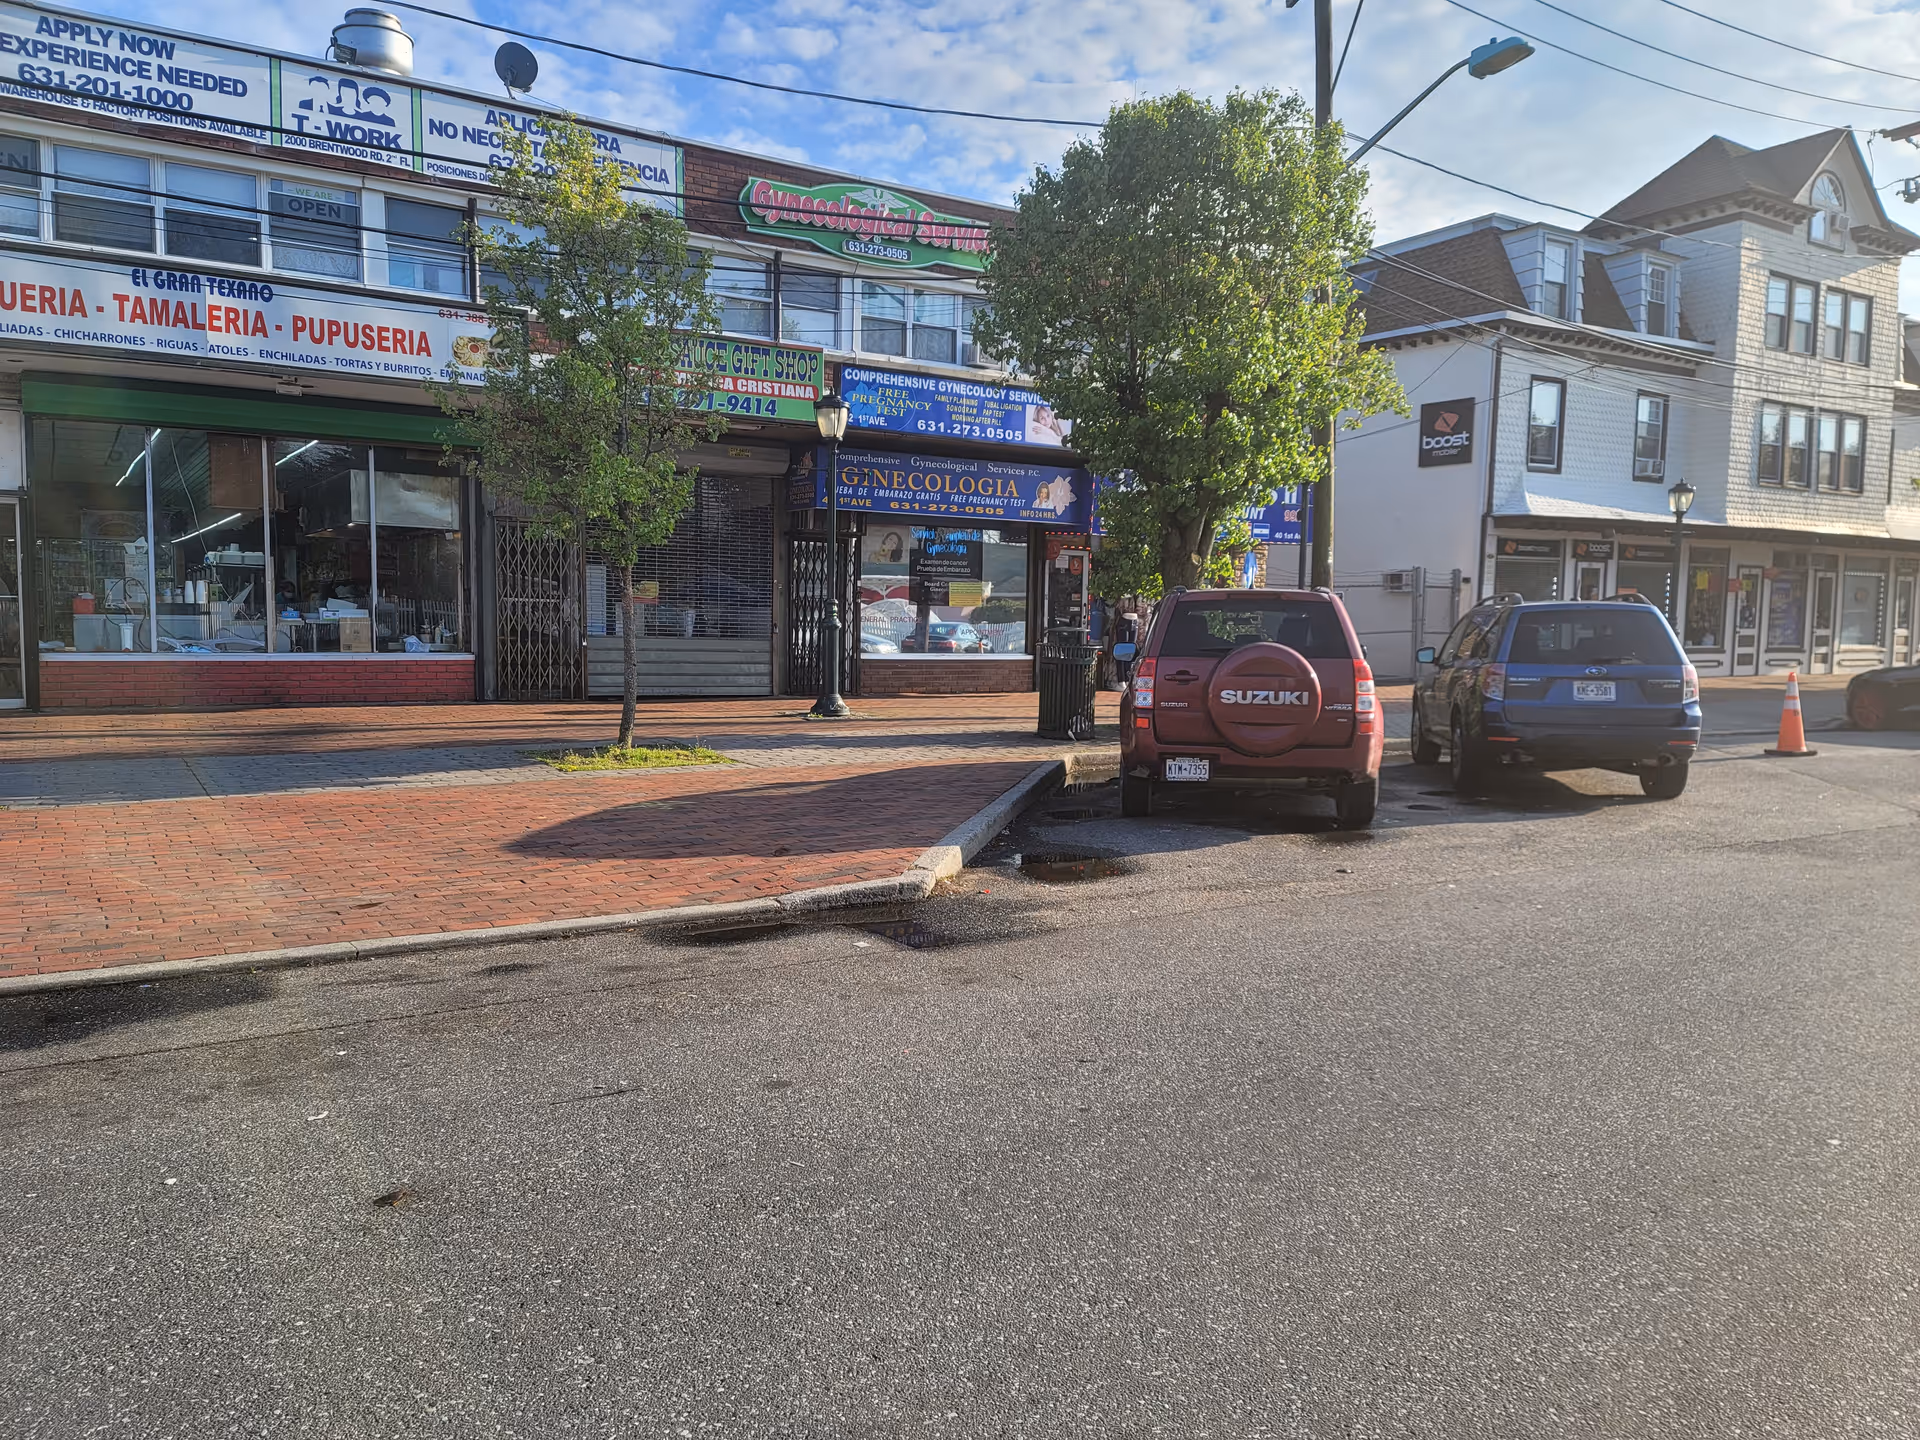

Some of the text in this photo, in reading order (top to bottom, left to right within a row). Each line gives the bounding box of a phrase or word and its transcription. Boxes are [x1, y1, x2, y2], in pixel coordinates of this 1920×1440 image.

[36, 15, 175, 60] APPLY NOW
[0, 32, 248, 98] EXPERIENCE NEEDED
[18, 63, 193, 110] 631-201-1000
[0, 82, 267, 140] WAREHOUSE & FACTORY POSITIONS AVAILABLE
[429, 118, 458, 139] NO
[285, 135, 307, 147] 2000
[309, 139, 368, 158] BRENTWOOD
[370, 151, 385, 162] RD.
[400, 157, 410, 167] FL
[427, 162, 478, 180] POSICIONES
[295, 187, 332, 200] WE ARE
[288, 199, 341, 219] OPEN
[751, 180, 916, 242] Gynecological
[849, 241, 908, 260] 631-273-0505
[131, 268, 274, 303] EL GRAN TEXANO
[113, 293, 269, 338] TAMALERIA
[292, 314, 432, 358] PUPUSERIA
[54, 328, 146, 346] CHICHARRONES
[156, 338, 198, 352] RIGUAS
[208, 344, 249, 357] ATOLES
[259, 349, 327, 365] ENCHILADAS
[334, 357, 373, 370] TORTAS
[376, 361, 381, 371] Y
[384, 363, 432, 377] BURRITOS
[732, 344, 771, 377] GIFT
[774, 349, 819, 382] SHOP
[737, 379, 815, 399] CRISTIANA
[844, 368, 936, 391] COMPREHENSIVE
[938, 380, 1007, 400] GYNECOLOGY
[852, 393, 1005, 418] PREGNANCY SONOGRAM PAP TEST
[878, 387, 1022, 411] FREE FAMILY PLANNING TUBAL LIGATION
[876, 405, 907, 417] TEST
[975, 416, 991, 425] AFTER
[992, 418, 1002, 426] PILL
[869, 416, 888, 427] AVE.
[917, 419, 1022, 441] 631.273.0505
[1422, 431, 1469, 449] boost
[910, 456, 978, 473] Gynecological
[987, 463, 1025, 476] Services
[1028, 469, 1041, 477] P.C.
[841, 466, 1020, 498] GINECOLOGIA
[851, 497, 872, 507] AVE
[889, 501, 1005, 516] 631-273-0505
[1020, 509, 1034, 518] INFO
[1035, 510, 1043, 518] 24
[858, 487, 868, 496] DE
[874, 488, 913, 500] EMBARAZO
[916, 491, 941, 501] GRATIS
[950, 494, 967, 503] FREE
[968, 496, 1008, 507] PREGNANCY
[1010, 499, 1026, 507] TEST
[1220, 689, 1309, 706] SUZUKI
